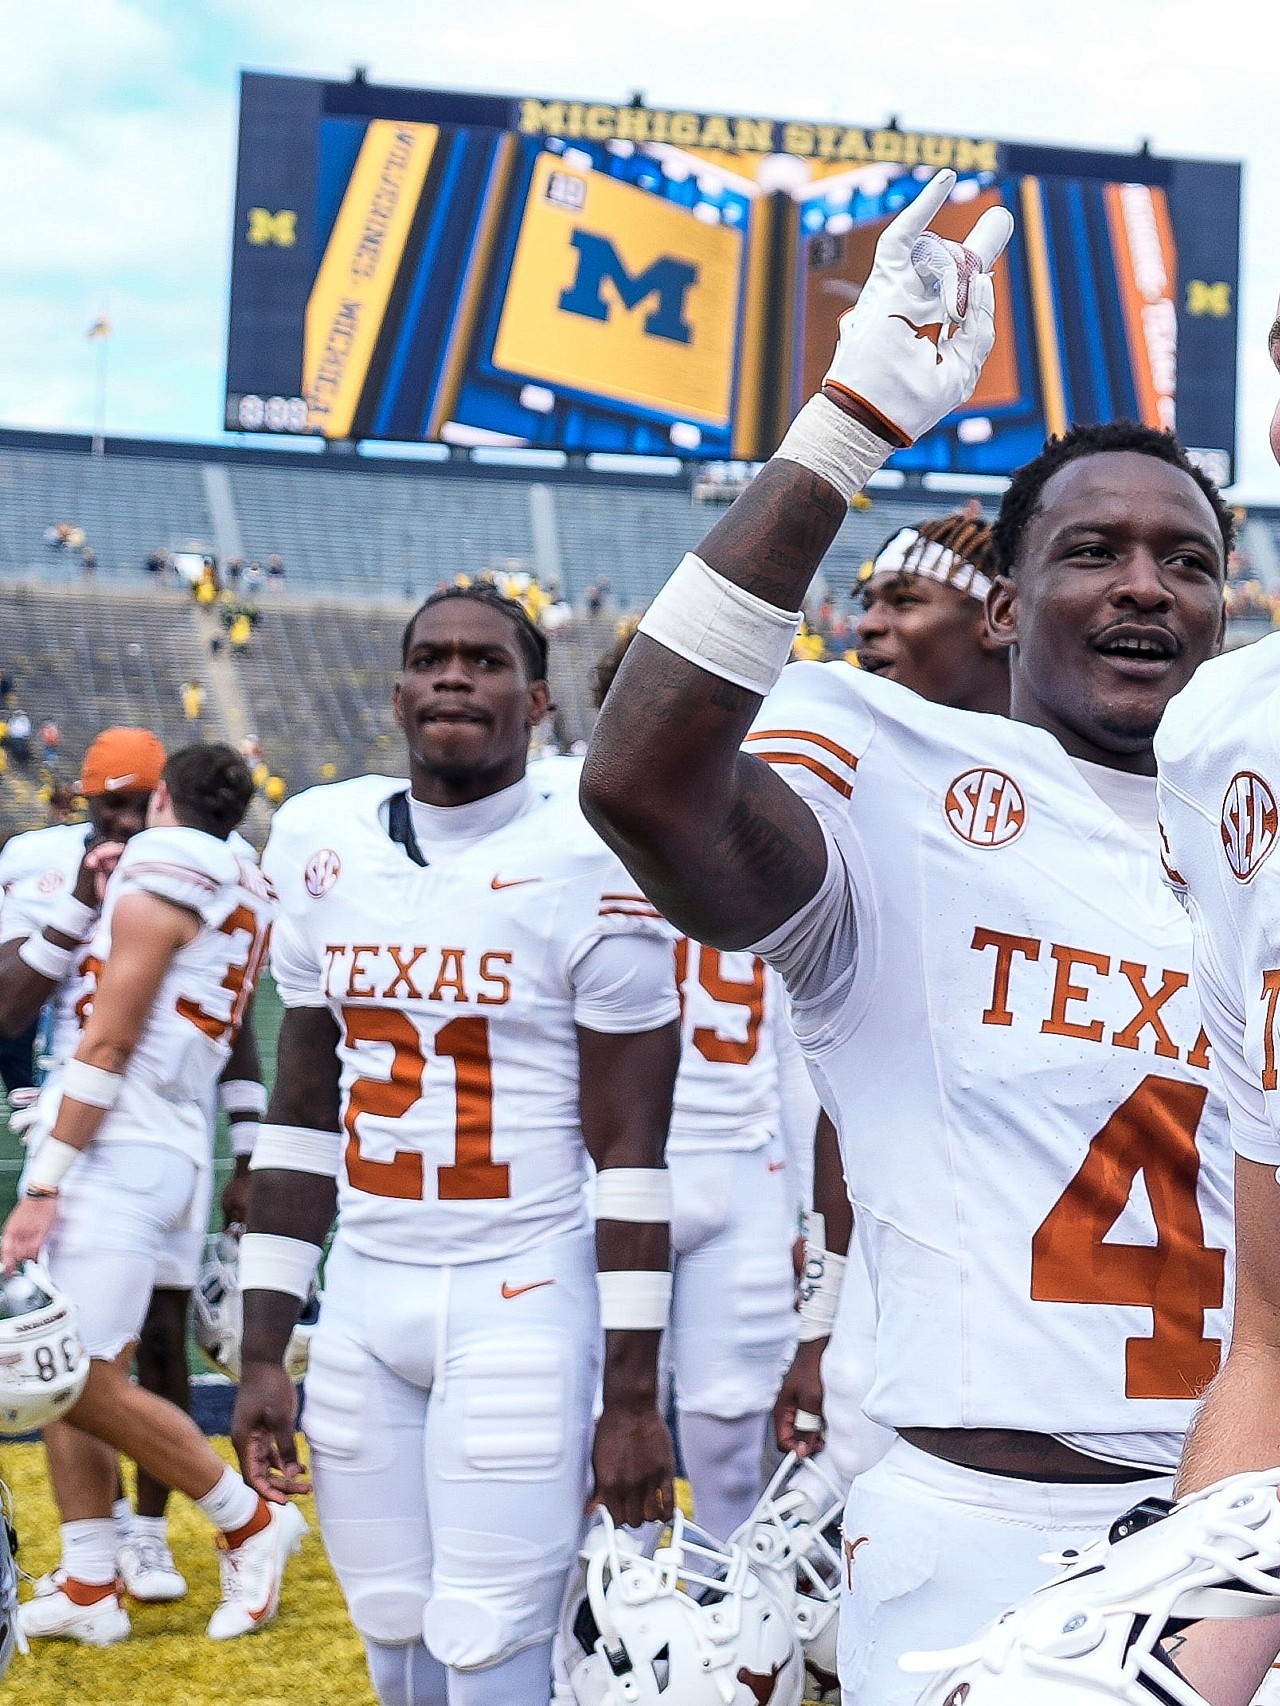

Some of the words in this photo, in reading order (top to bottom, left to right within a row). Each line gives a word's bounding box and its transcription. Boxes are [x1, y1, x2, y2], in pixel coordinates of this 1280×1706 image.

[520, 99, 773, 151] MICHIGAN
[782, 122, 997, 171] STADIUM
[248, 208, 297, 247] M
[559, 228, 700, 344] M
[1186, 279, 1232, 318] M
[947, 770, 1023, 844] SEC
[325, 945, 513, 1005] TEXAS
[971, 926, 1211, 1068] TEX
[342, 1006, 510, 1200] 21
[1031, 1074, 1226, 1399] 4
